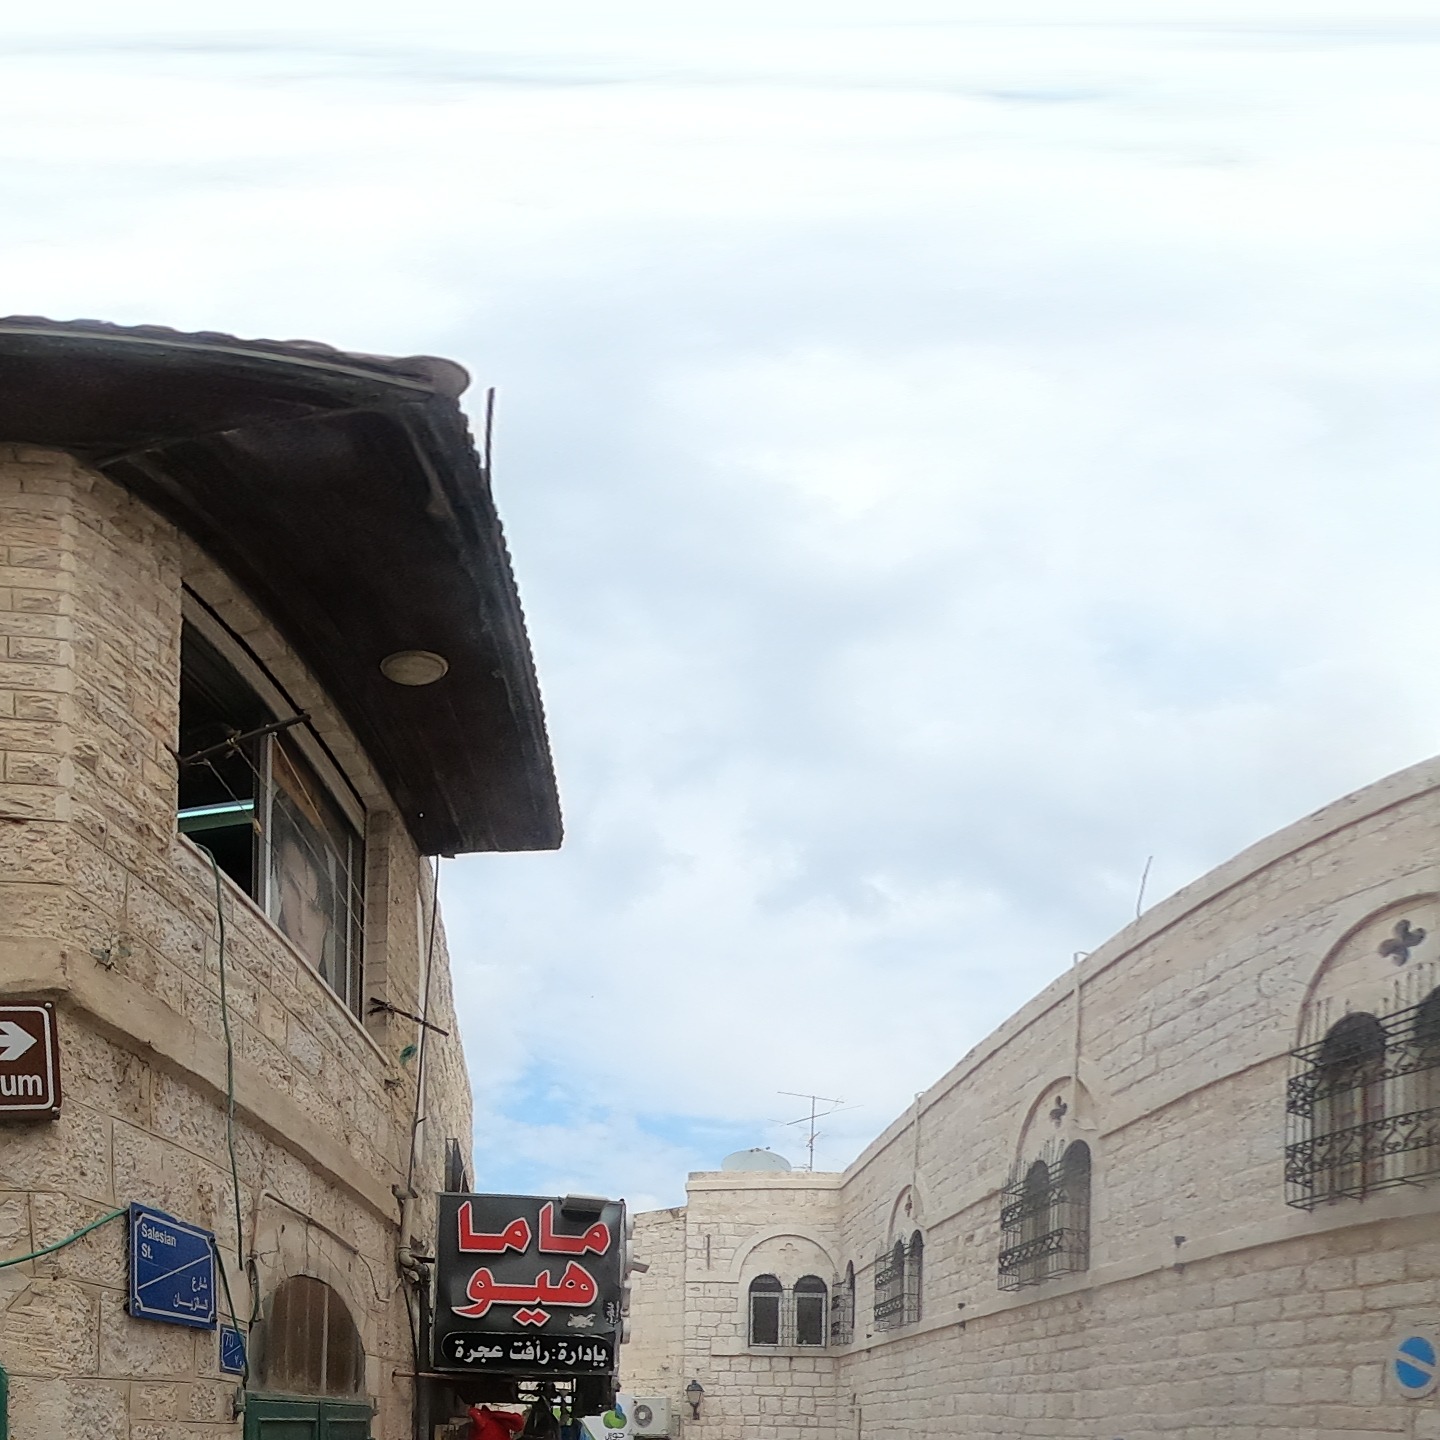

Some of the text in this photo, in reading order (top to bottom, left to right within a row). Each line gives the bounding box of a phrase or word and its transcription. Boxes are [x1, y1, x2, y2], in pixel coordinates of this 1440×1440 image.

[141, 1222, 177, 1247] Salesian
[457, 1200, 611, 1256] ماما
[141, 1243, 153, 1259] St.
[191, 1276, 207, 1293] شارع
[451, 1260, 598, 1328] هيو
[454, 1340, 504, 1363] عجرة
